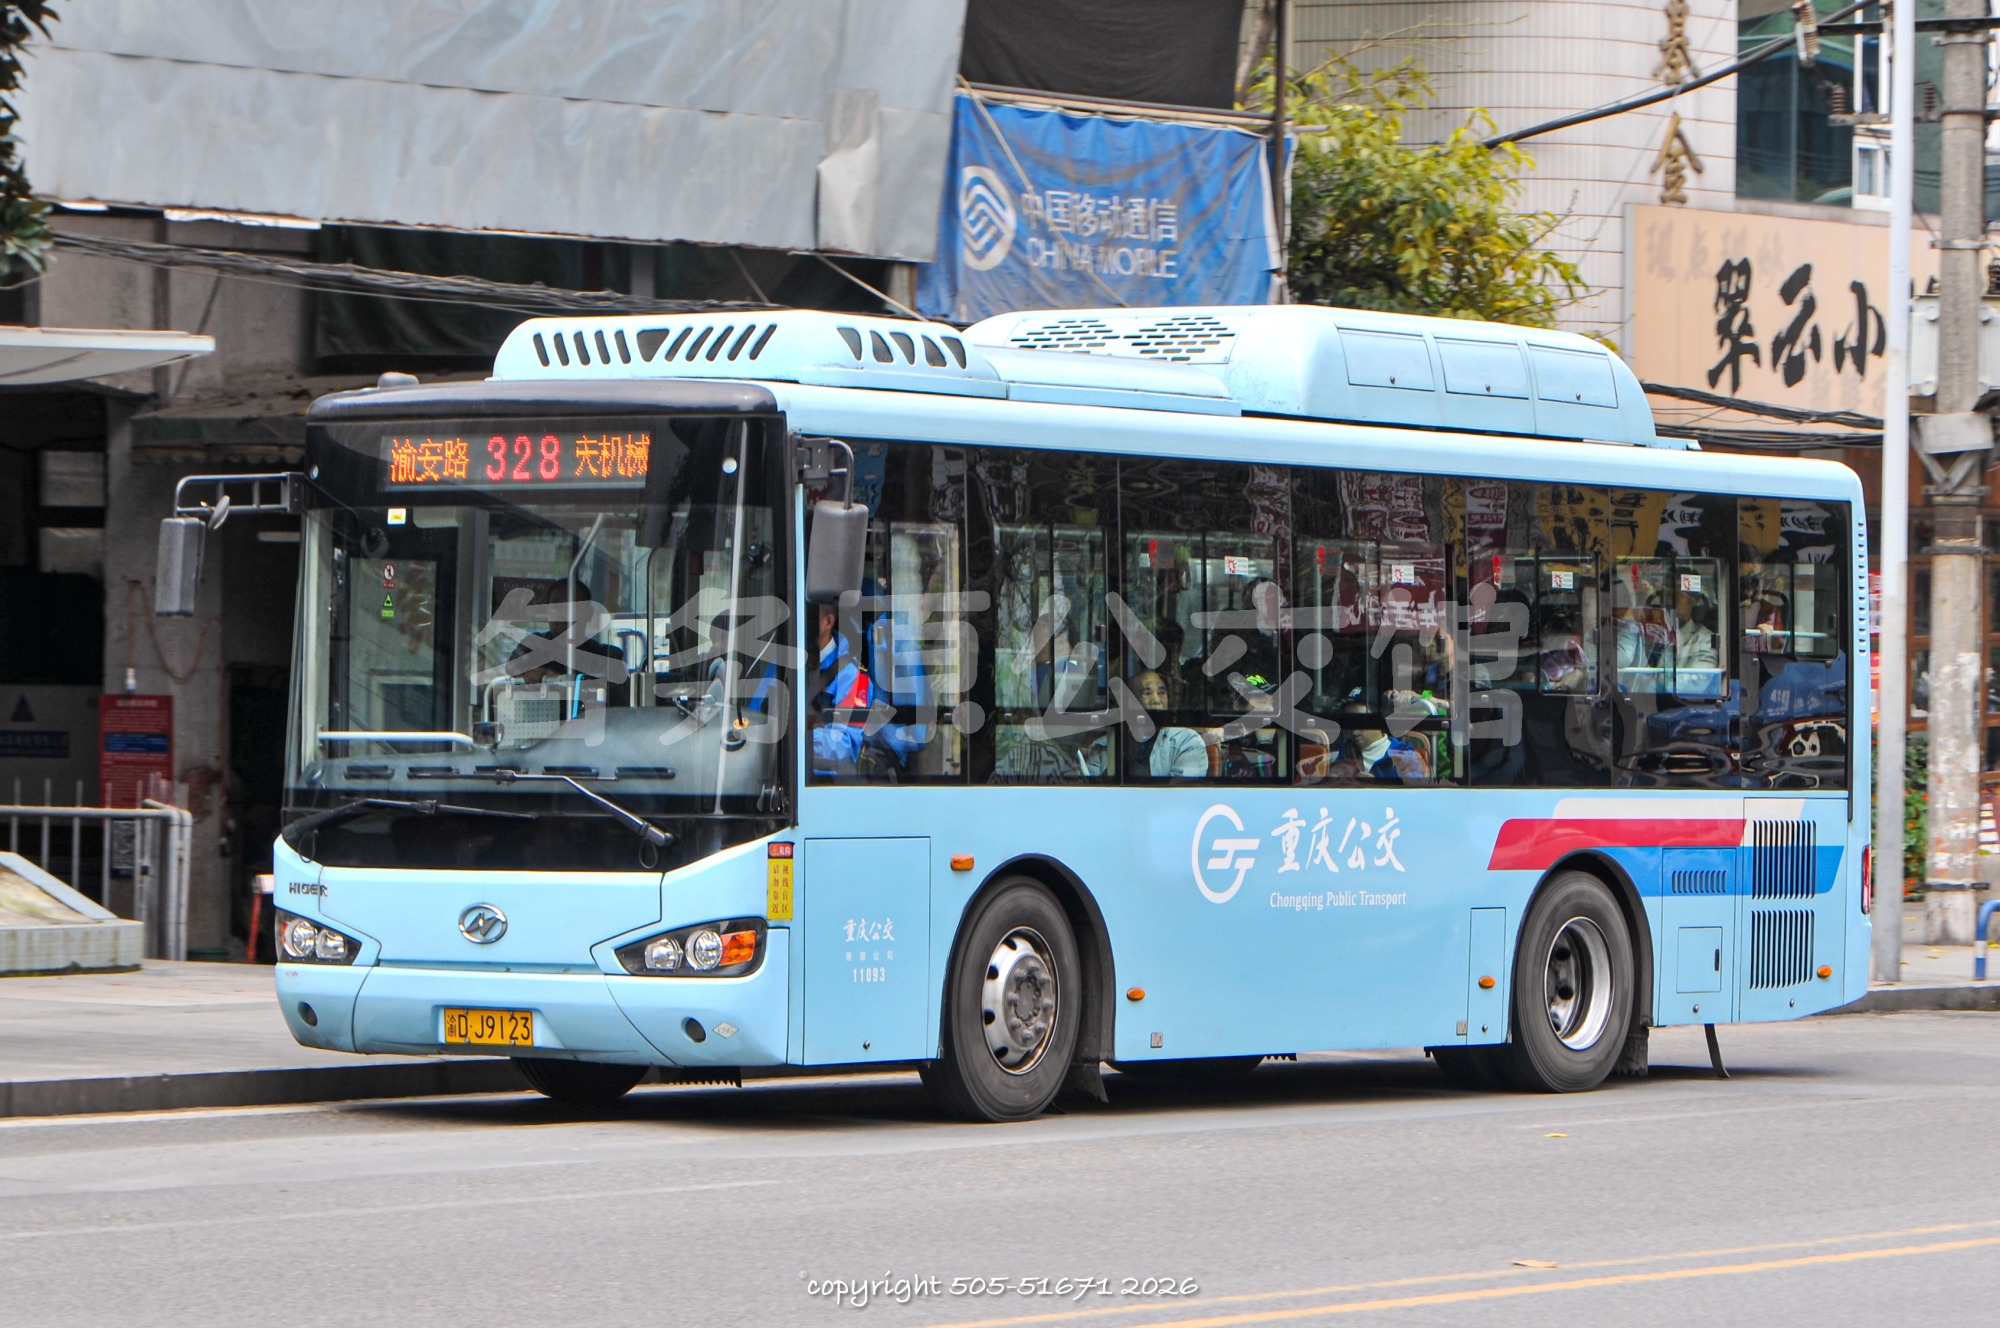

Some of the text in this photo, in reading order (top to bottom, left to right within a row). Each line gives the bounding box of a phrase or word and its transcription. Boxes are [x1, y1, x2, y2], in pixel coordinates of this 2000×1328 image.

[1021, 190, 1178, 242] 中国移动通信
[1026, 237, 1178, 278] CHINA MOBILE
[1708, 257, 1912, 393] 翠云小
[391, 437, 470, 482] 渝安路
[486, 435, 560, 481] 328
[1270, 807, 1406, 873] 重庆公交
[288, 882, 328, 897] HIGER
[1270, 890, 1406, 911] Chongqing Public Transport
[843, 918, 895, 942] 重庆公交
[852, 966, 886, 983] 11093
